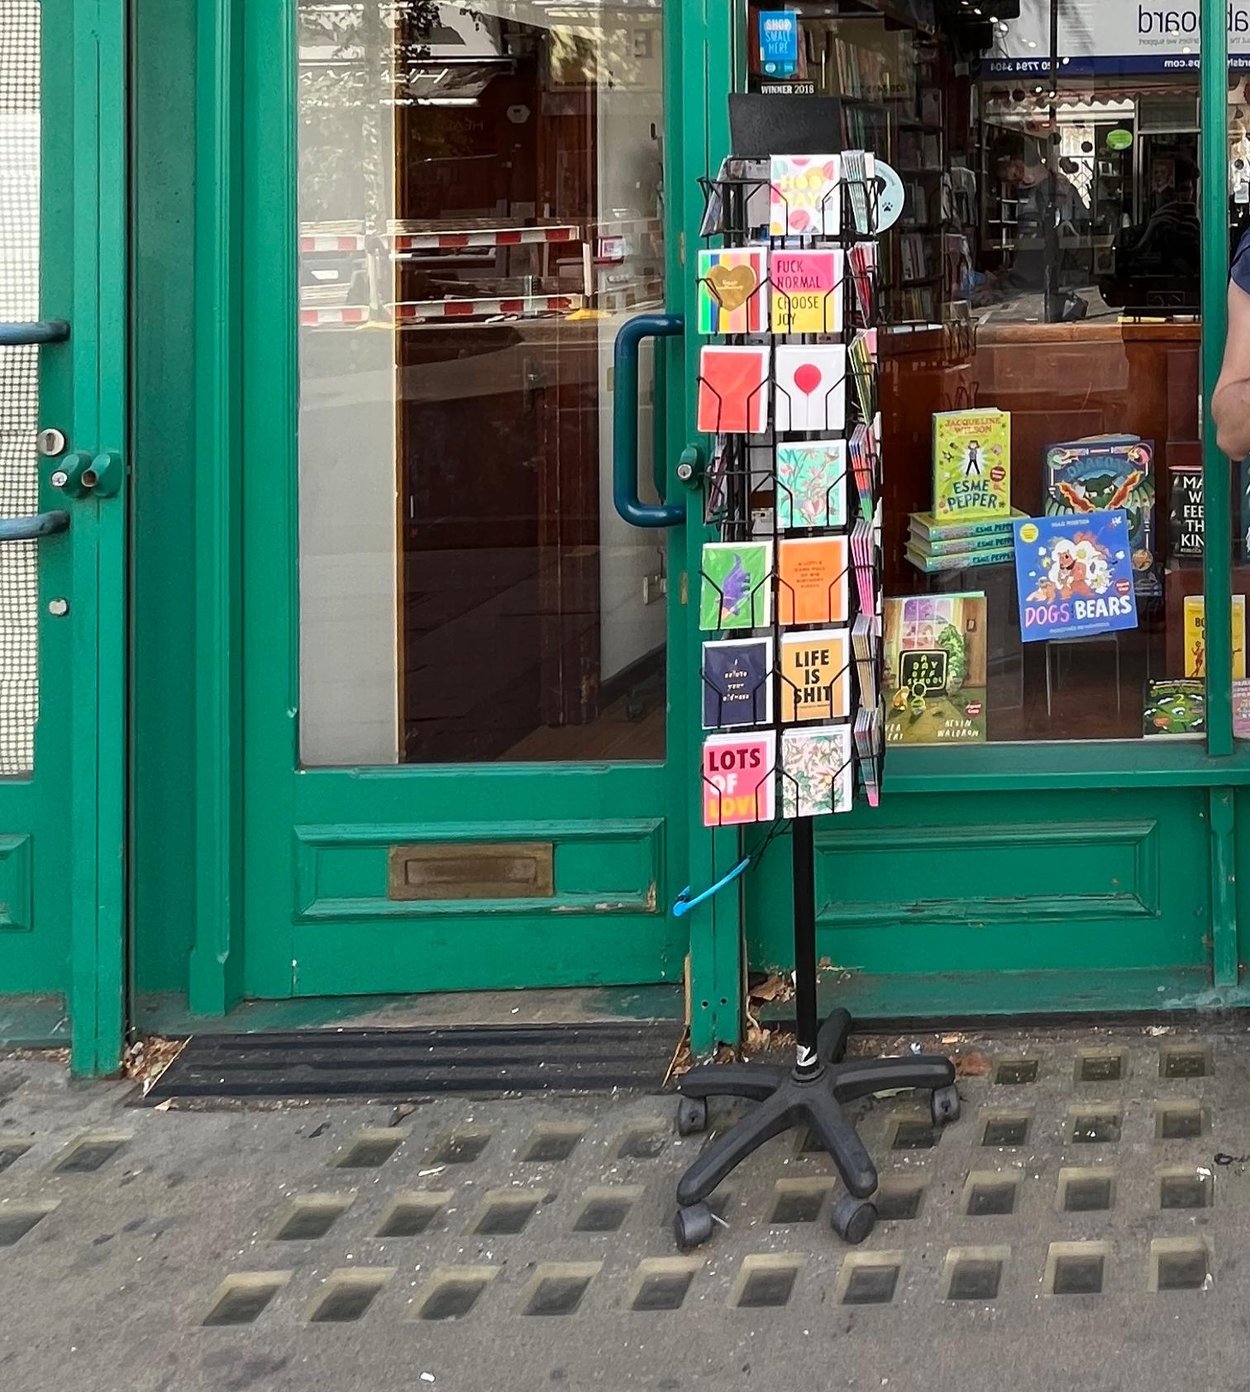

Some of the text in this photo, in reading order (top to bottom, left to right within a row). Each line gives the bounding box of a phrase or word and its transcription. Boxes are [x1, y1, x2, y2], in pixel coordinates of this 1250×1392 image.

[765, 19, 792, 31] SHOP
[765, 31, 791, 43] SMALL
[768, 42, 788, 55] HERE
[761, 85, 815, 94] WINNER 2018
[777, 259, 804, 273] FUCK
[777, 276, 822, 289] NORMAL
[777, 295, 820, 310] CHOOSE
[777, 312, 797, 327] JOY
[944, 416, 1001, 427] JACQUELINE
[953, 424, 992, 434] WILSON
[953, 479, 991, 494] ESME
[1183, 476, 1204, 489] MA
[947, 493, 998, 511] PEPPER
[1188, 490, 1203, 504] W
[1183, 505, 1205, 518] FEE
[994, 523, 1013, 532] PEPP
[1185, 519, 1205, 532] TH
[1181, 533, 1205, 547] KIN
[1025, 595, 1133, 627] DOGS BEARS
[795, 649, 830, 668] LIFE
[920, 654, 927, 662] A
[913, 661, 938, 670] DAY
[804, 669, 820, 685] IS
[907, 676, 943, 685] SCHOOL
[912, 670, 935, 678] OFF
[794, 685, 832, 705] SHIT
[1174, 693, 1185, 704] 2
[937, 729, 979, 737] WALDRON
[709, 748, 760, 772] LOTS
[709, 773, 739, 795] OF
